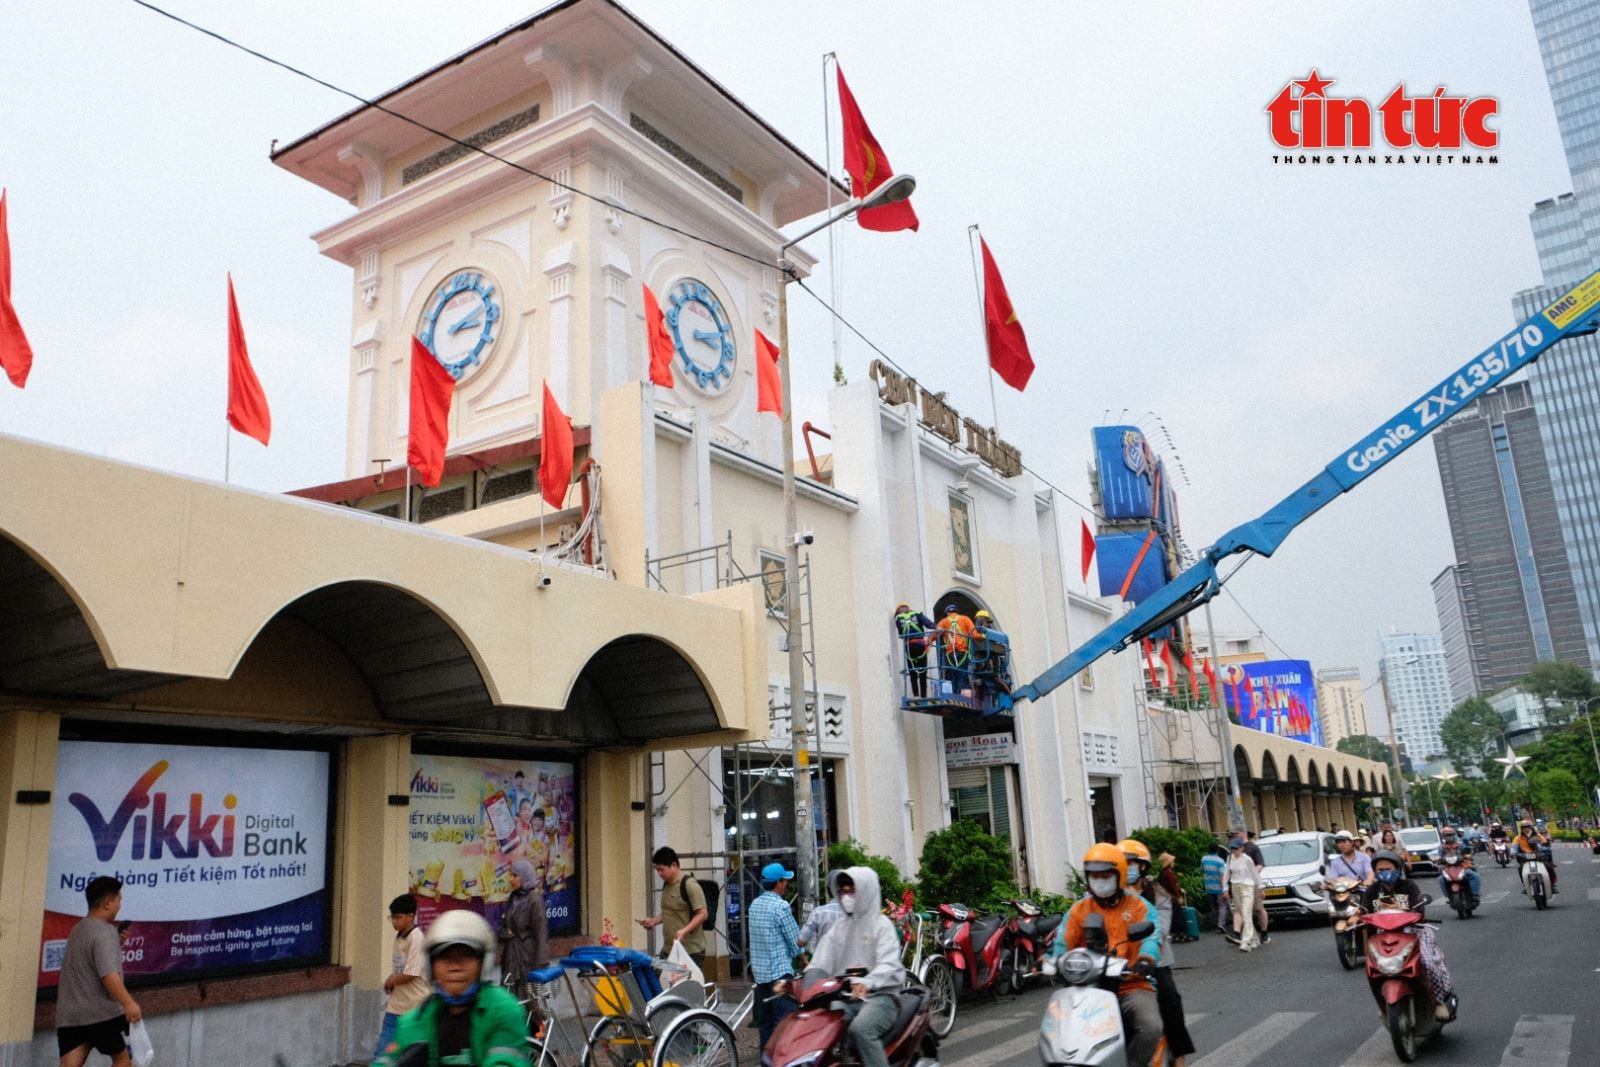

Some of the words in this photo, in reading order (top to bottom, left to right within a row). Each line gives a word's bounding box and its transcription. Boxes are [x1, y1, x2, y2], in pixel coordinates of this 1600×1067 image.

[1548, 296, 1578, 320] AMC
[1346, 423, 1418, 473] Genie
[69, 760, 238, 862] Vikki
[245, 815, 295, 830] Digital
[409, 810, 425, 825] IẾT
[452, 813, 475, 825] Vikki
[243, 832, 308, 857] Bank
[60, 872, 98, 893] Ngâ
[114, 869, 159, 888] hàng
[163, 864, 197, 884] Tiết
[200, 866, 238, 886] kiệm
[242, 862, 266, 880] Tốt
[269, 860, 307, 879] nhất!
[171, 932, 202, 945] Chạm
[171, 945, 183, 957] Be
[184, 942, 223, 956] inspired,
[225, 939, 250, 952] ignite
[251, 940, 271, 951] your
[271, 936, 296, 947] future
